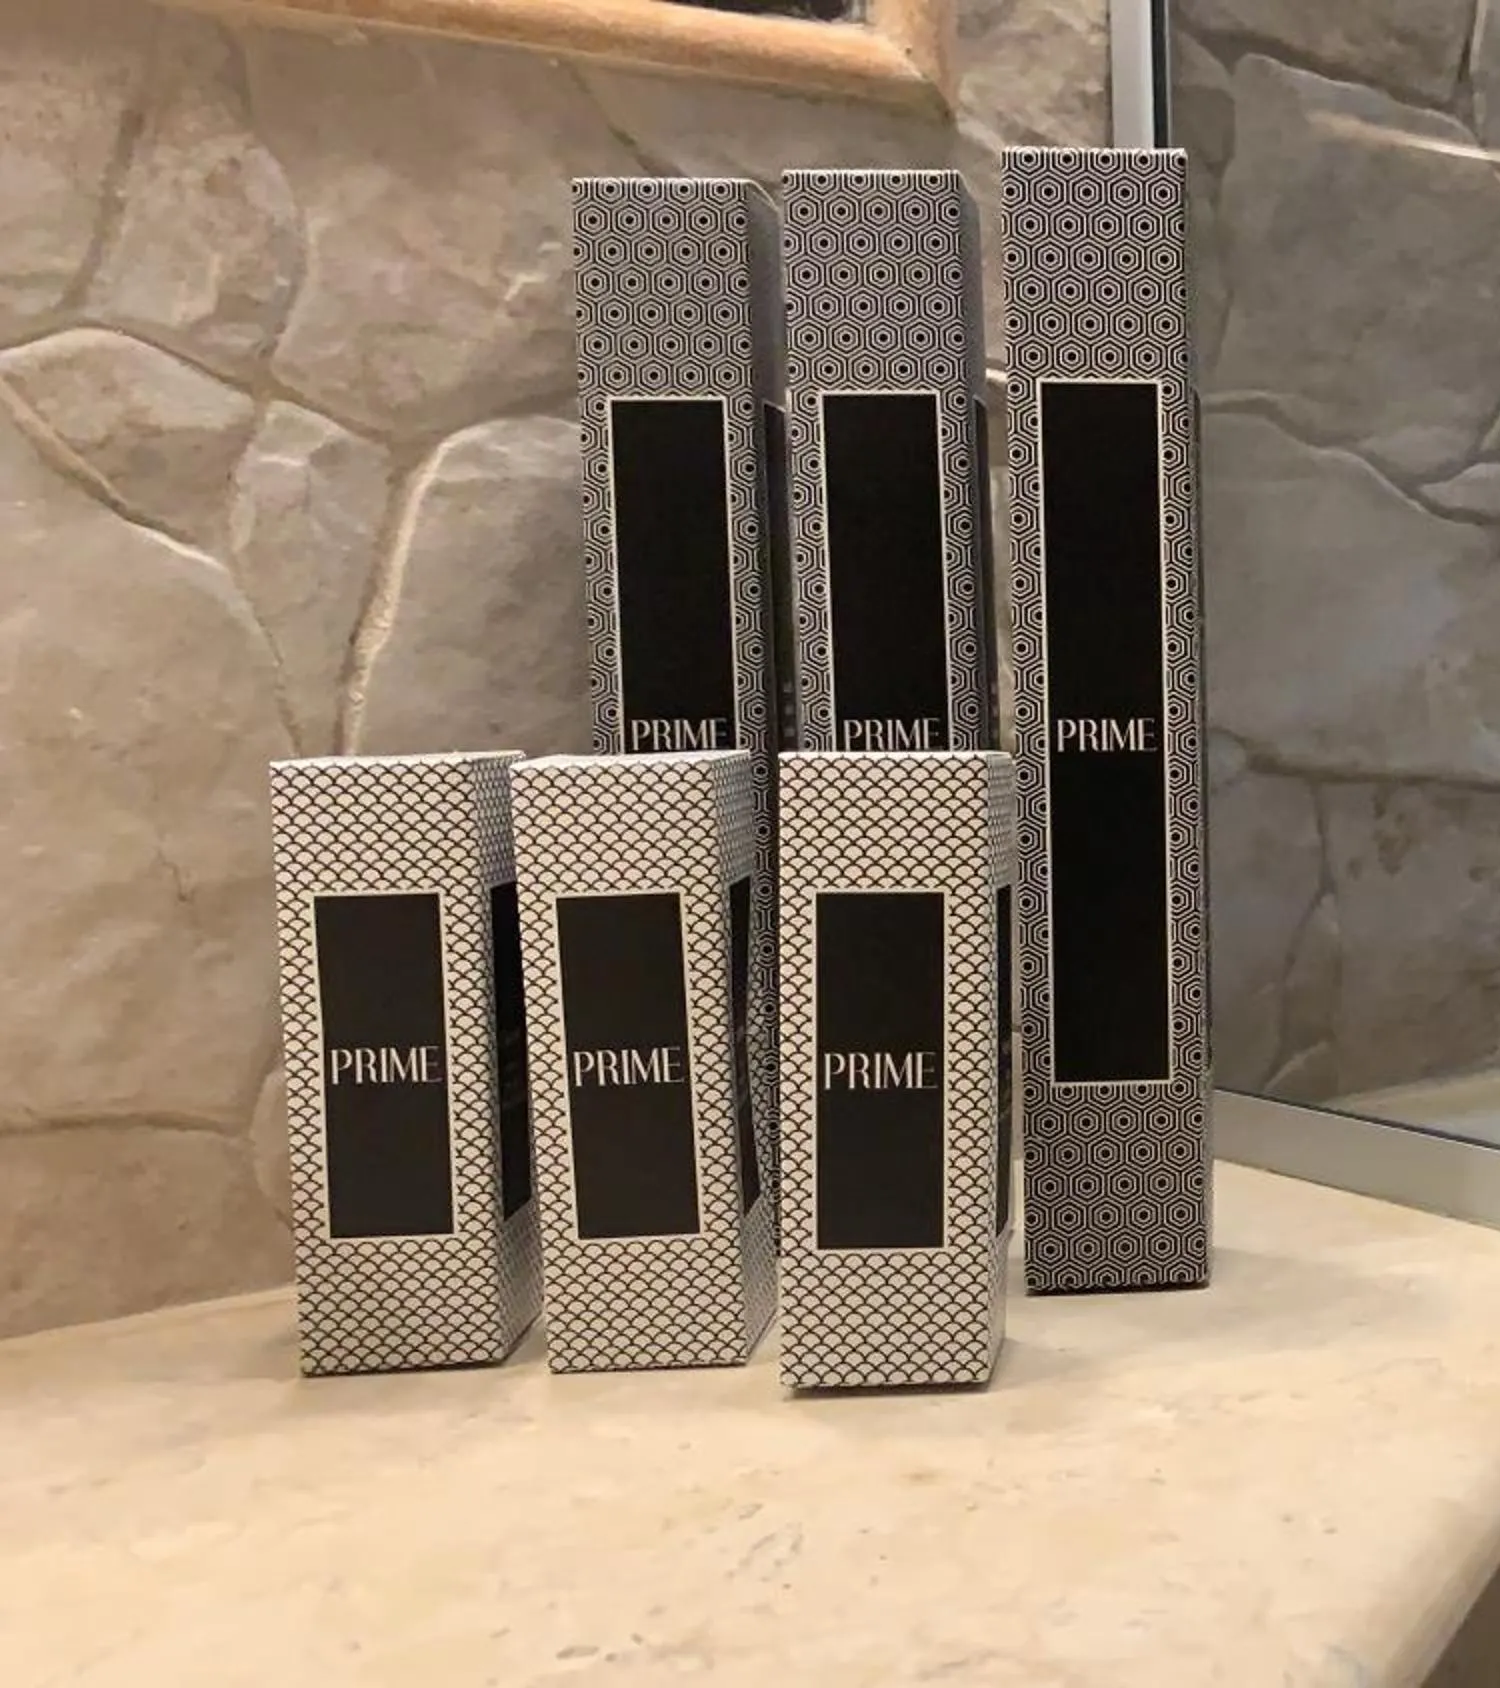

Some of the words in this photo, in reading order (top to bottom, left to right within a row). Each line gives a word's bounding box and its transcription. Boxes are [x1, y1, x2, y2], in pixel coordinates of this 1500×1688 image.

[630, 718, 728, 749] PRIME
[842, 718, 940, 749] PRIME
[1056, 718, 1157, 751] PRIME
[329, 1045, 441, 1084] PRIME
[573, 1046, 685, 1086] PRIME
[823, 1052, 938, 1089] PRIME
